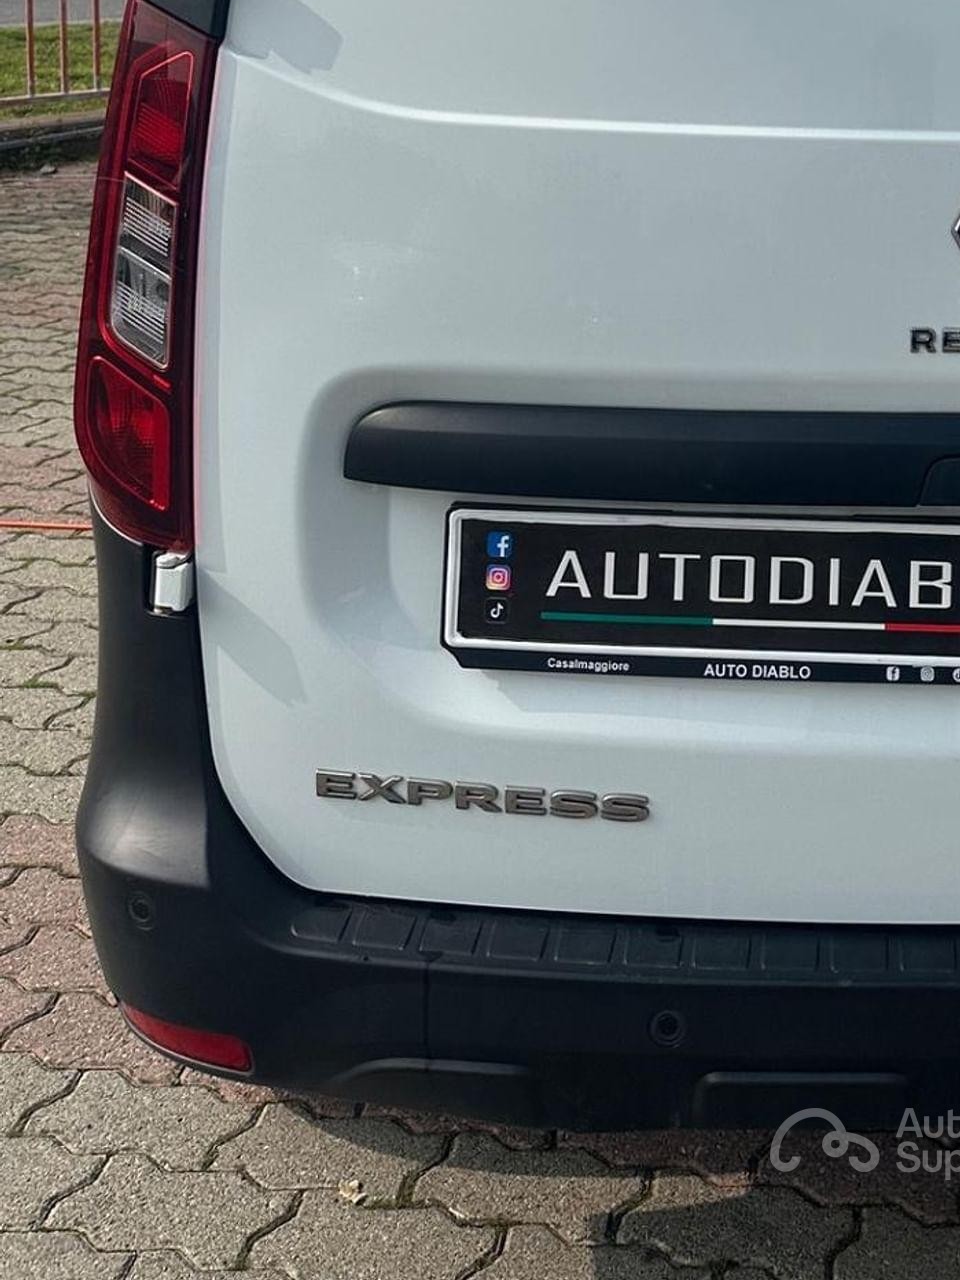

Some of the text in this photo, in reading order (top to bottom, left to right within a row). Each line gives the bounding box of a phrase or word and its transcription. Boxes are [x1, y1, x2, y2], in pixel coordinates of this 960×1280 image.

[547, 657, 630, 674] Casalmaggiore
[703, 663, 812, 680] AUTO DIABLO
[315, 767, 651, 822] EXPRESS
